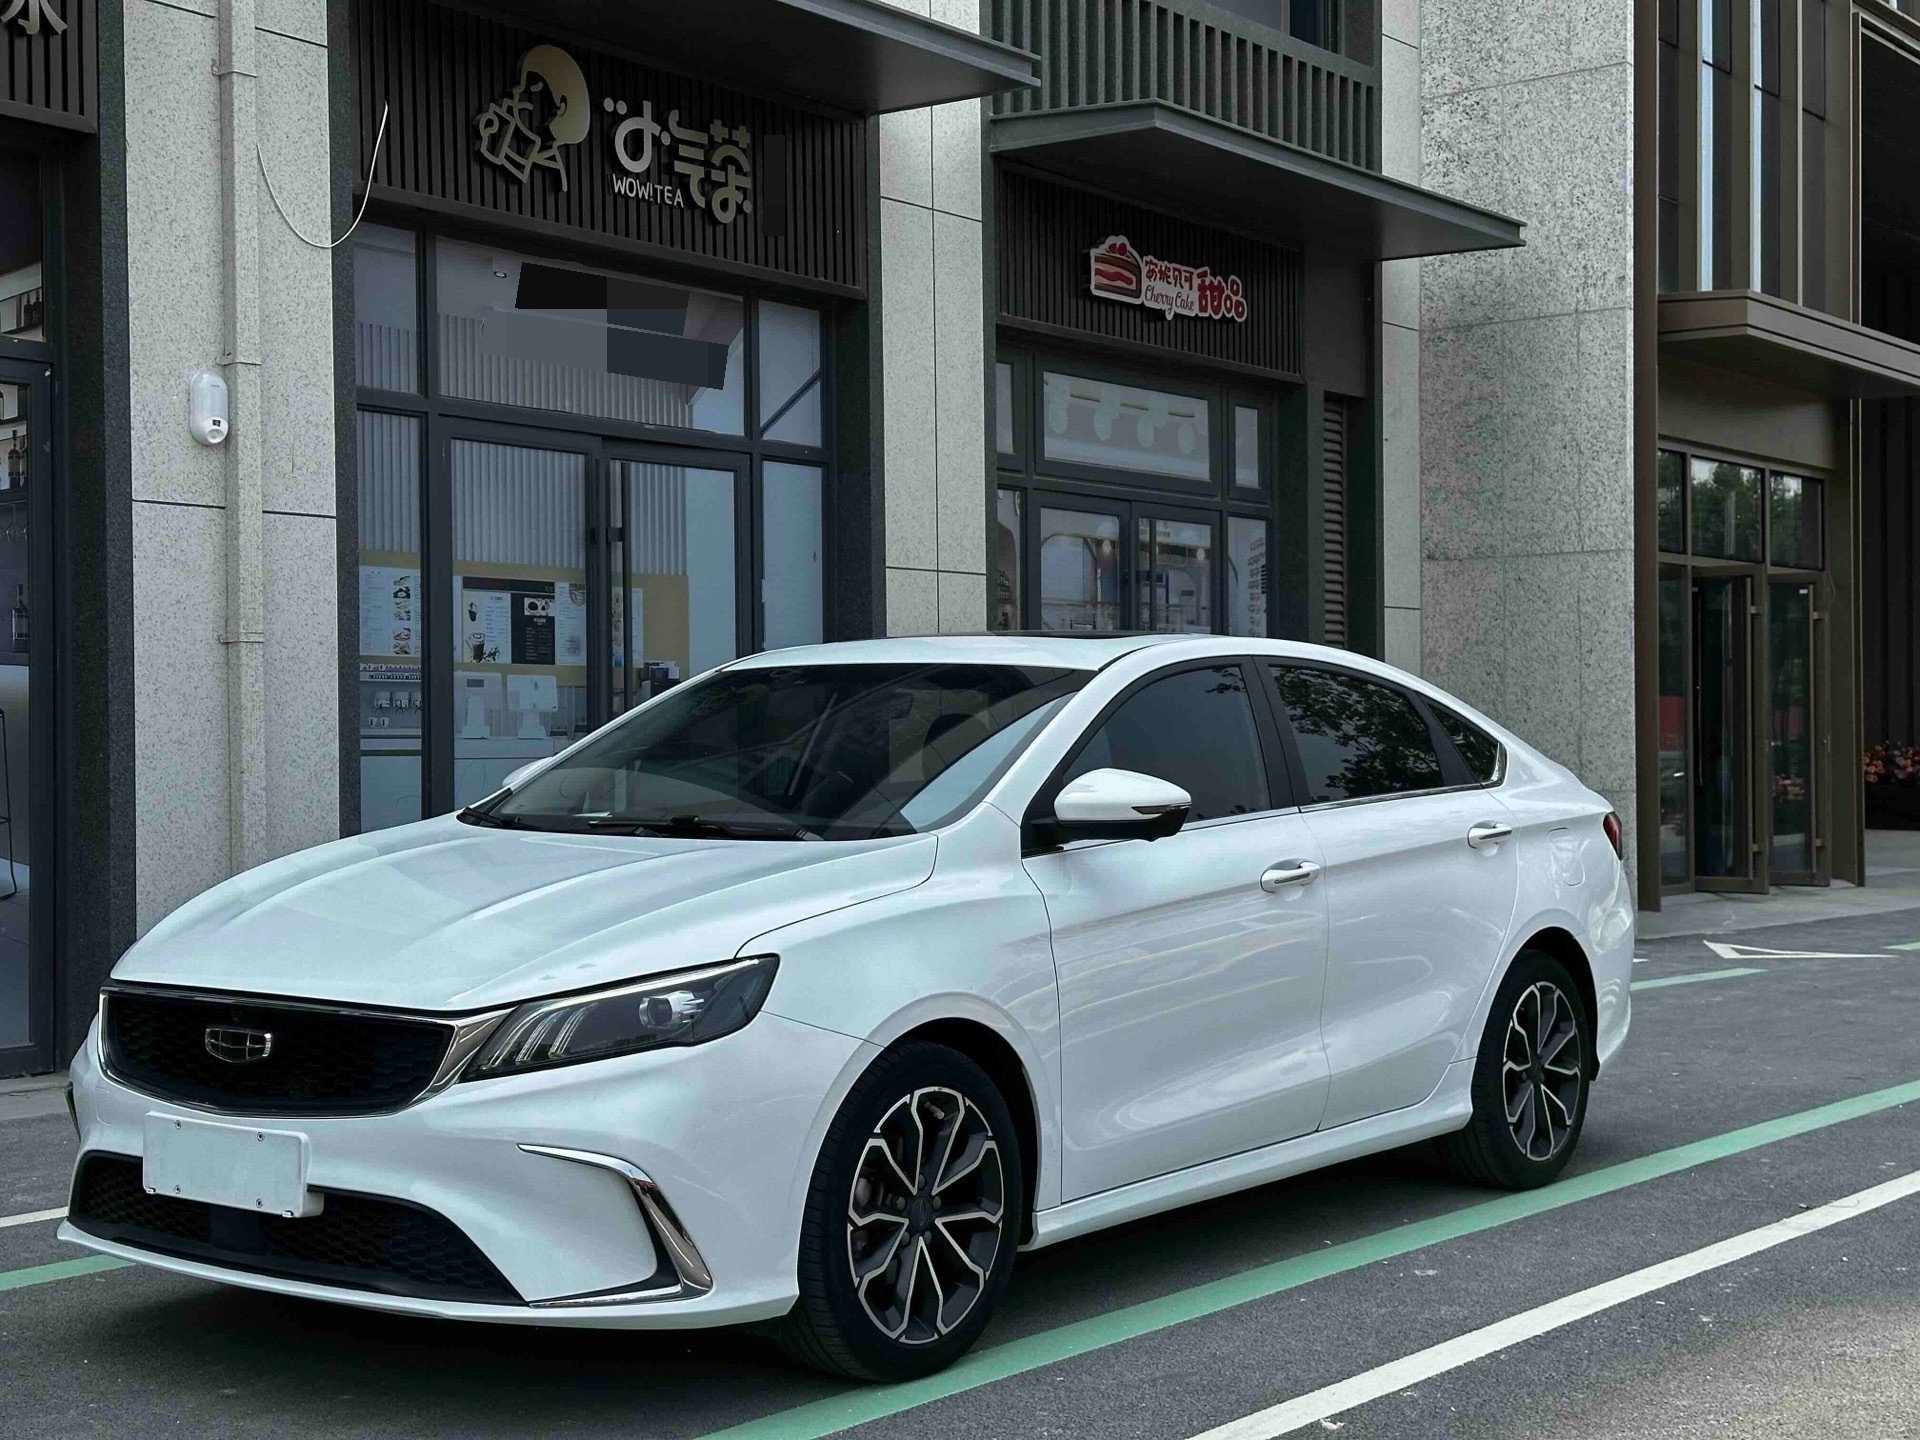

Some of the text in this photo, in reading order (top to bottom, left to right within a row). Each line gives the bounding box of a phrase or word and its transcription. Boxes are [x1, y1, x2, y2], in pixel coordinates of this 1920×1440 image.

[612, 173, 685, 209] WOW!TEA
[1144, 284, 1195, 314] Cherry Cake
